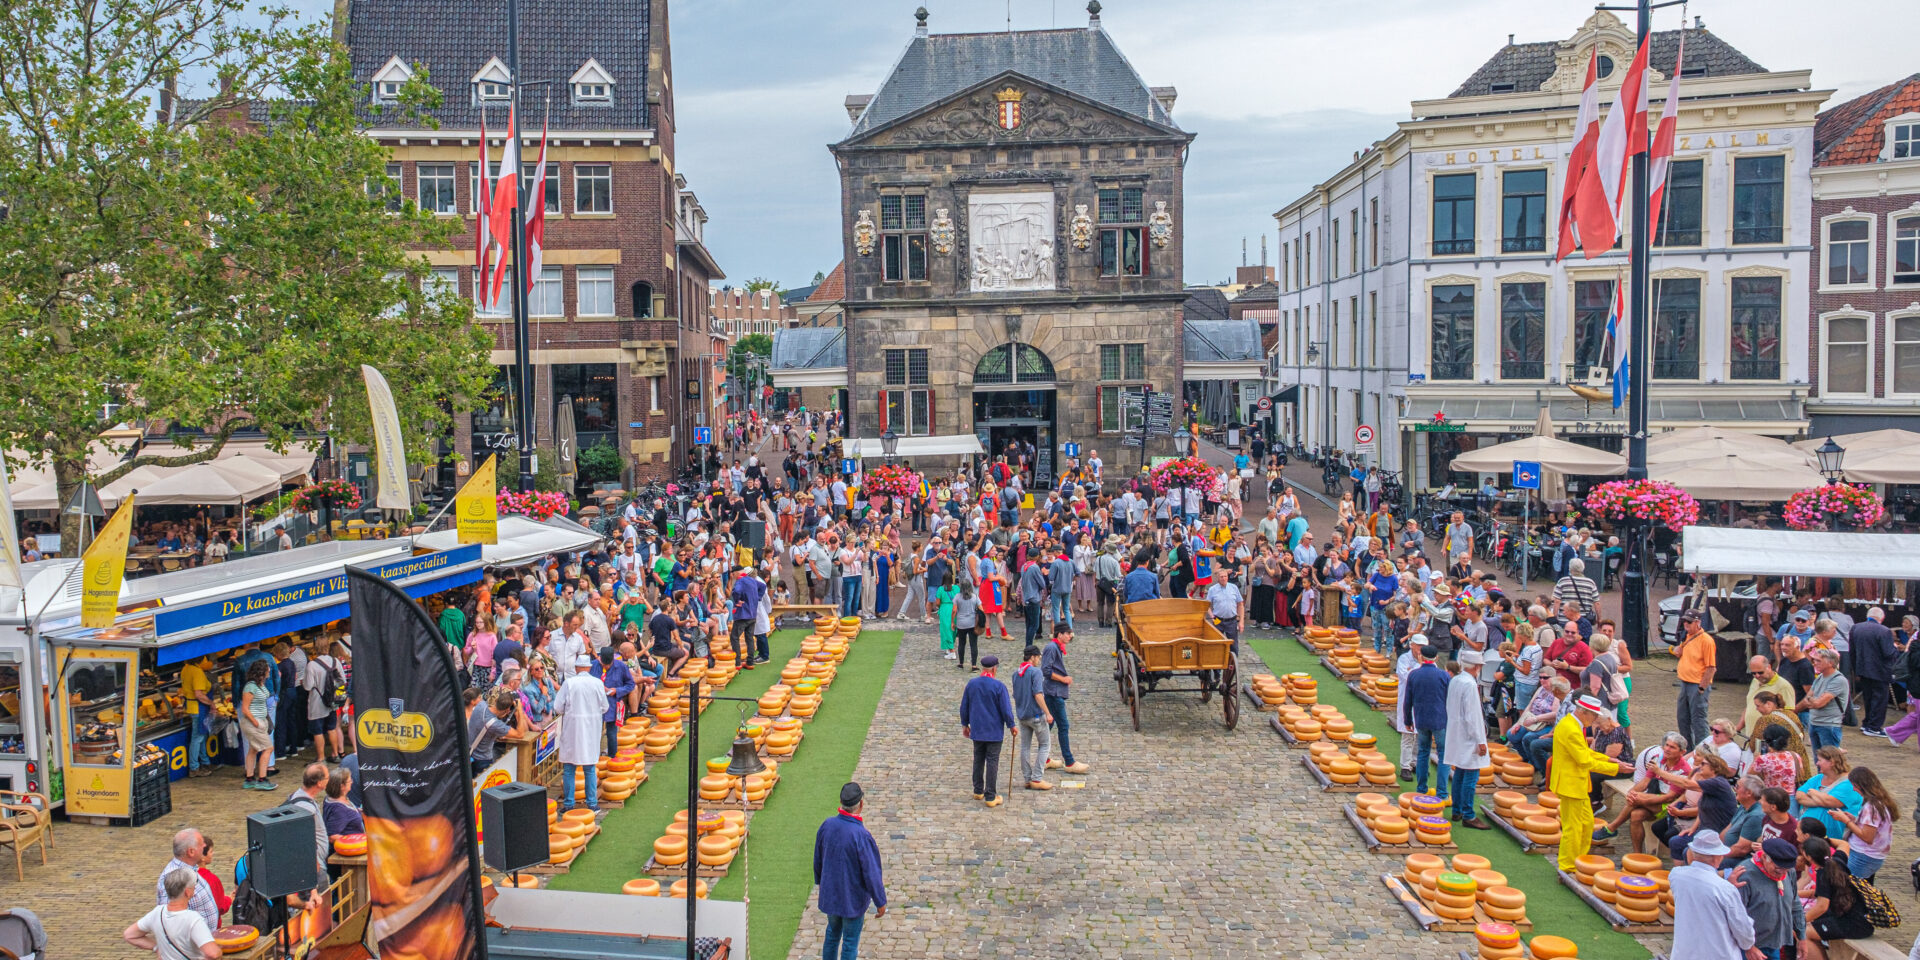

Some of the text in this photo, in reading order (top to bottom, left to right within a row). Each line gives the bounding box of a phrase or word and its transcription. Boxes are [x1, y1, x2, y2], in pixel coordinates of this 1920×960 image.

[1446, 132, 1769, 165] HOTEL ZALM
[1414, 423, 1466, 432] Heineken
[1595, 422, 1625, 433] ZALM
[379, 555, 448, 579] kaasspecialist
[222, 601, 242, 617] De
[246, 589, 305, 611] kaasboer
[309, 581, 326, 597] uit
[364, 721, 426, 739] VERGEER
[82, 789, 120, 798] Hogendoorn
